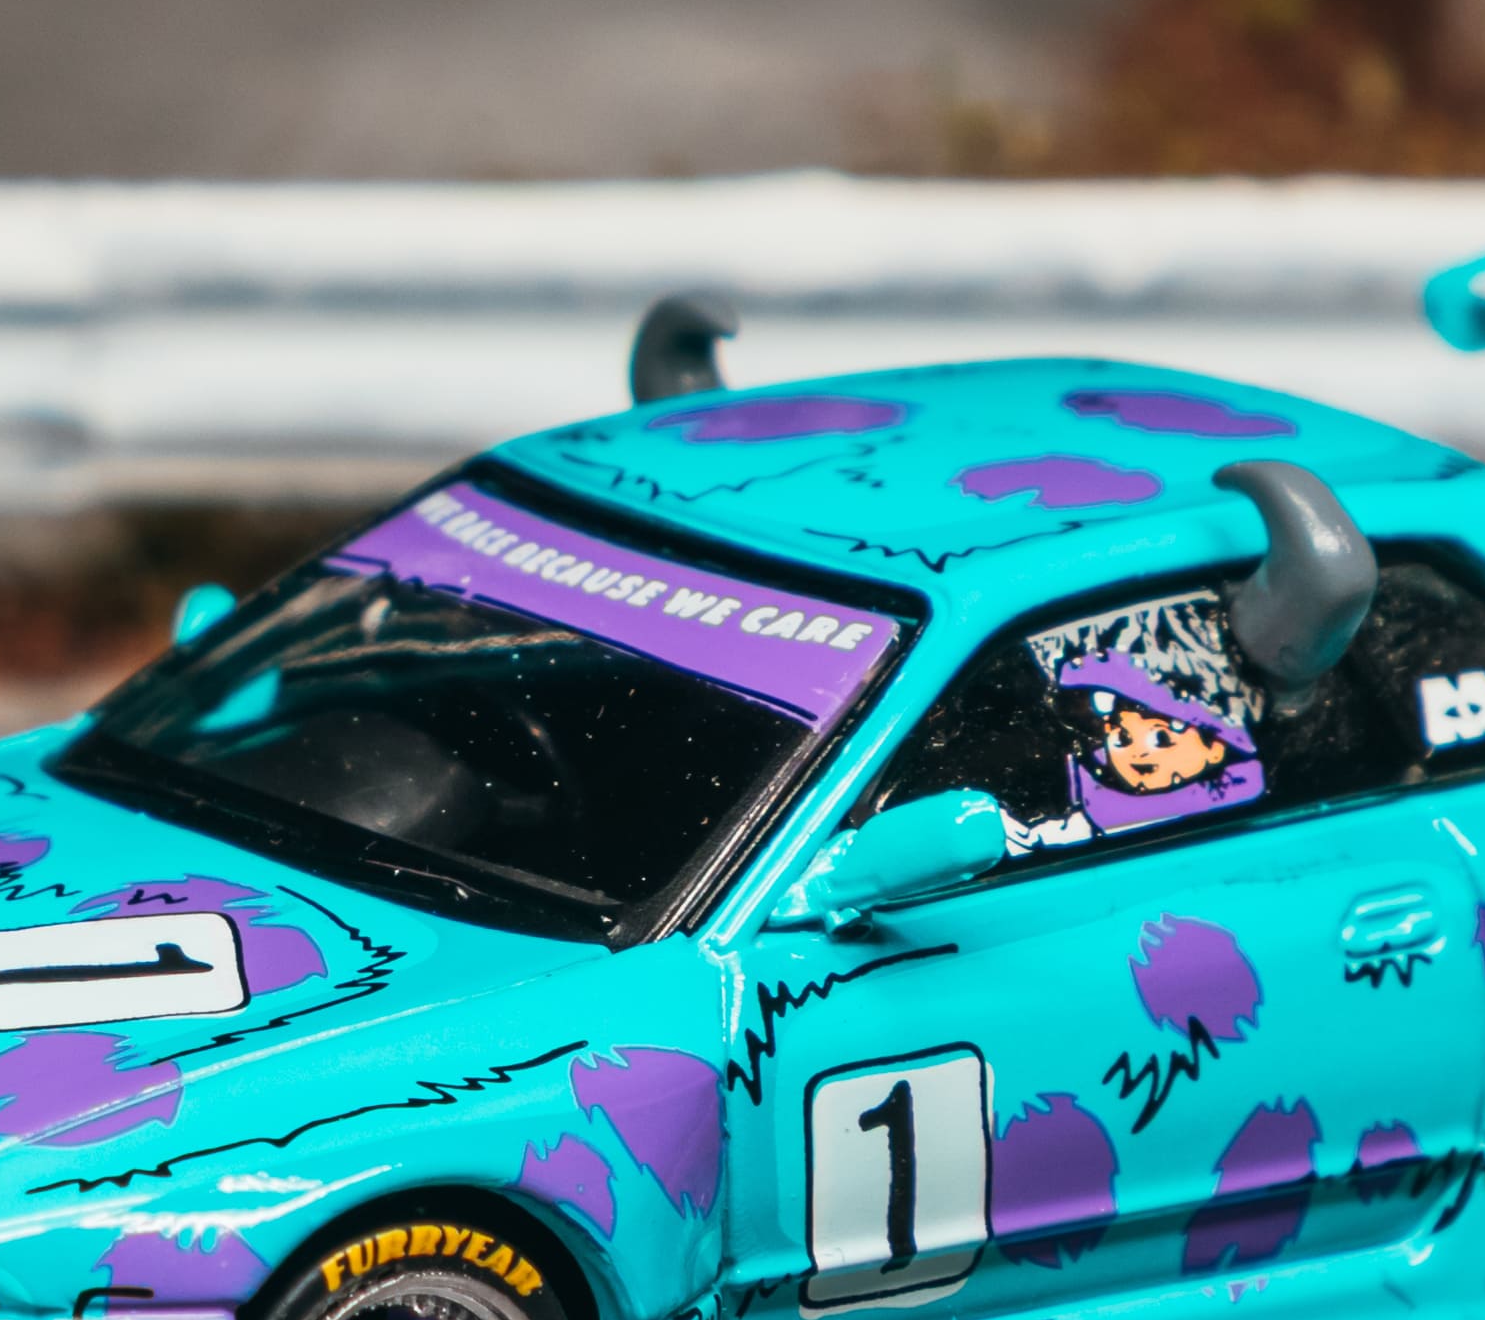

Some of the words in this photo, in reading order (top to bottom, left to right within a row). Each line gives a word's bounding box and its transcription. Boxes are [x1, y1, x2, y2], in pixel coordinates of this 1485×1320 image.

[440, 511, 519, 556] RACE
[502, 541, 668, 608] BECAUSE
[662, 586, 743, 627] WE
[739, 605, 874, 652] CARE
[857, 1078, 916, 1275] 1
[320, 1224, 544, 1297] FURRYEAR
